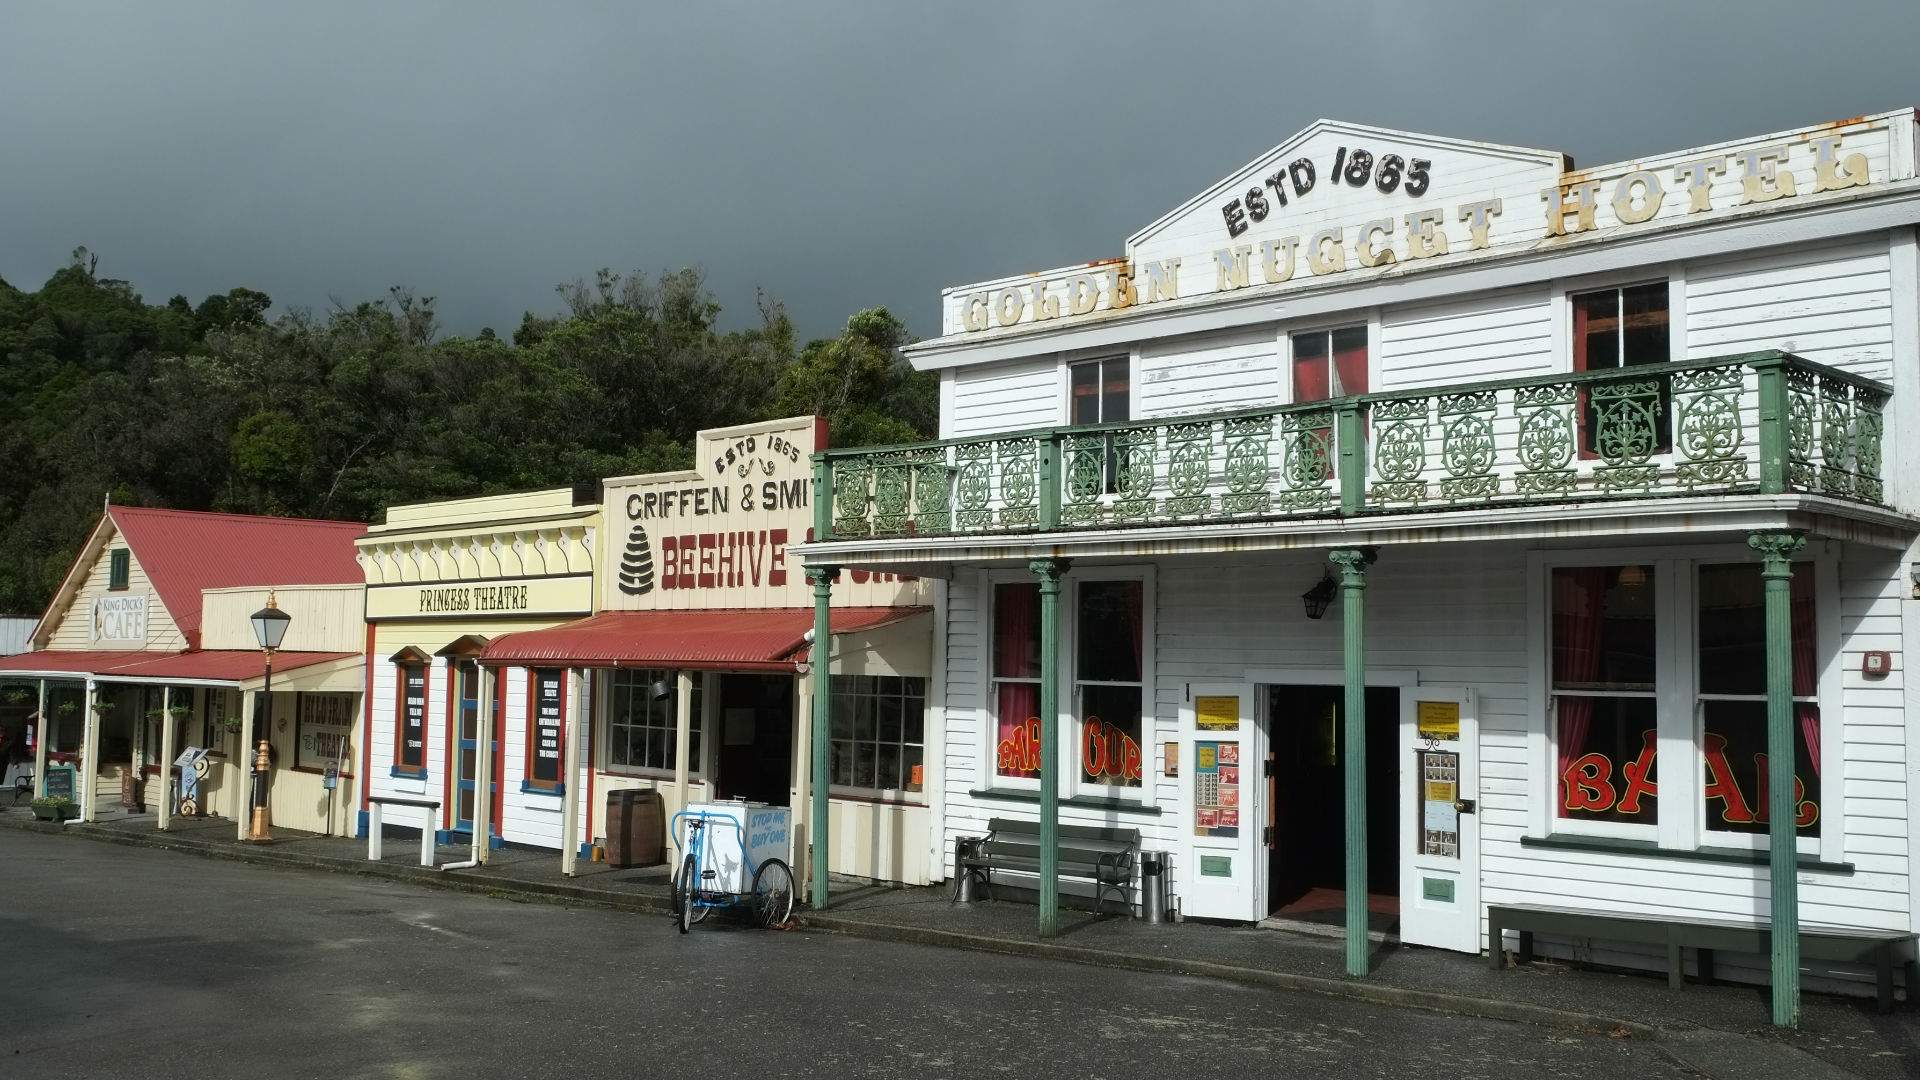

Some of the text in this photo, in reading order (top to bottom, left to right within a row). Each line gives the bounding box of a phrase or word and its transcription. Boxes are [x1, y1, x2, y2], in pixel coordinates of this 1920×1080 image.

[1221, 146, 1432, 239] ESTD 1865
[960, 256, 1182, 333] GOLDEN
[1541, 134, 1870, 238] HOTEL
[714, 435, 801, 475] ESTD 1865
[740, 483, 755, 512] &
[661, 528, 788, 590] BEEHIVE
[103, 599, 120, 611] KING
[419, 585, 528, 612] PRINCESS THEATRE
[103, 611, 143, 639] CAFE
